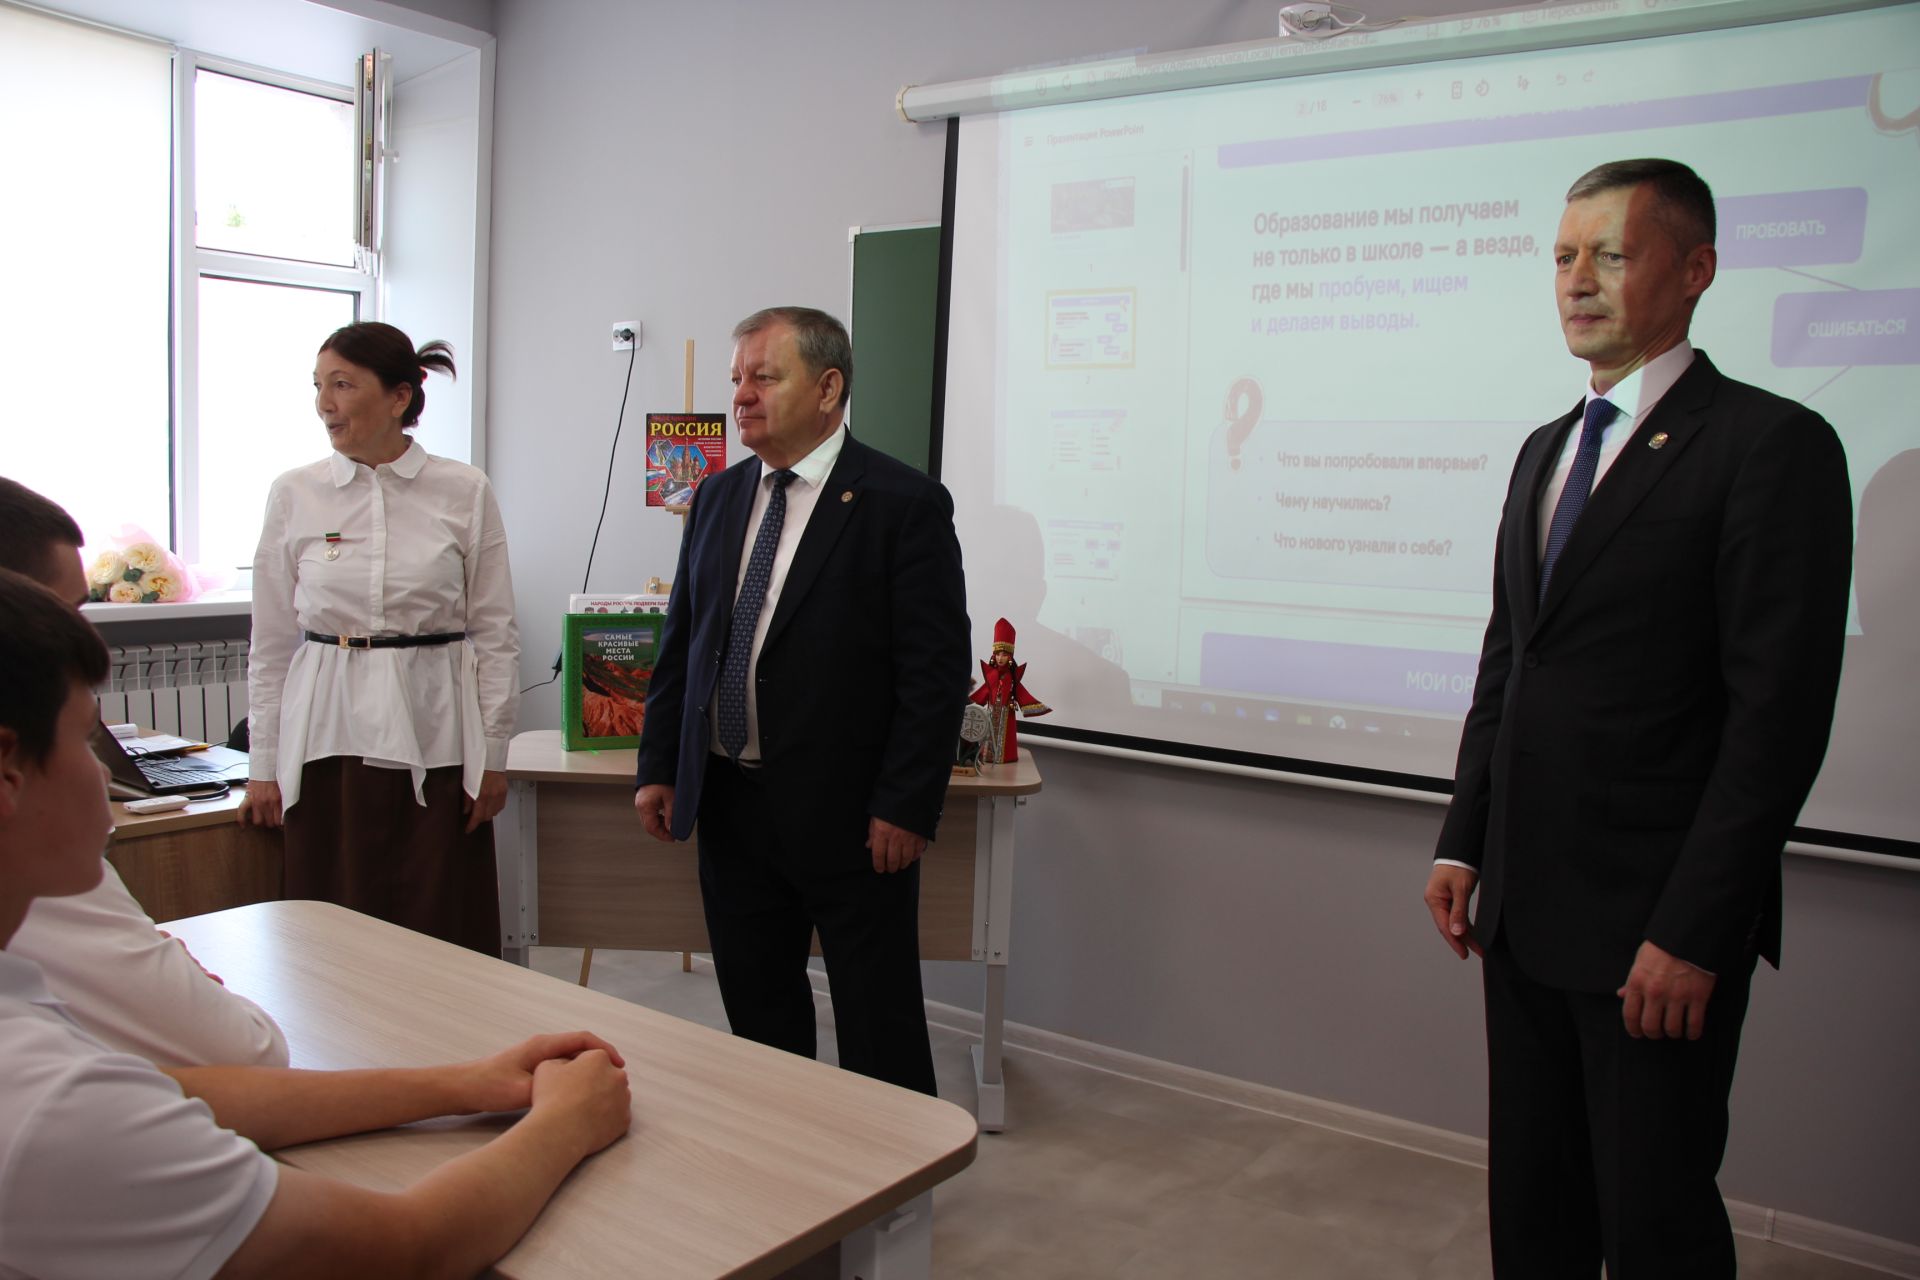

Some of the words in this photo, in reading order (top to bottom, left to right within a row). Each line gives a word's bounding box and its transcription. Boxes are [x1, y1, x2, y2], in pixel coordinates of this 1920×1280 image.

[1099, 123, 1144, 138] PowerPoint
[1253, 211, 1379, 238] Образование
[1383, 206, 1414, 226] мы
[1418, 199, 1519, 227] получаем
[1735, 220, 1826, 241] ПРОБОВАТЬ
[1252, 250, 1275, 268] не
[1279, 244, 1342, 266] только
[1345, 246, 1357, 263] в
[1361, 241, 1425, 263] школе
[1455, 238, 1468, 257] а
[1473, 233, 1541, 258] везде,
[1251, 283, 1282, 303] где
[1286, 281, 1314, 299] мы
[1318, 275, 1407, 301] пробуем,
[1412, 273, 1469, 296] ищем
[1250, 317, 1262, 334] и
[1266, 311, 1335, 337] делаем
[1339, 310, 1421, 334] выводы.
[1807, 319, 1906, 338] ОШИБАТЬСЯ
[650, 422, 722, 437] РОССИЯ
[1277, 450, 1300, 468] Что
[1303, 454, 1321, 468] вы
[1324, 452, 1414, 472] попробовали
[1416, 453, 1488, 474] впервые?
[1275, 490, 1309, 512] Чему
[1312, 494, 1391, 514] научились?
[1273, 531, 1297, 549] Что
[1300, 535, 1345, 552] нового
[1347, 538, 1396, 556] узнали
[1399, 542, 1408, 554] о
[1410, 539, 1453, 557] себе?
[1405, 669, 1447, 693] МОИ
